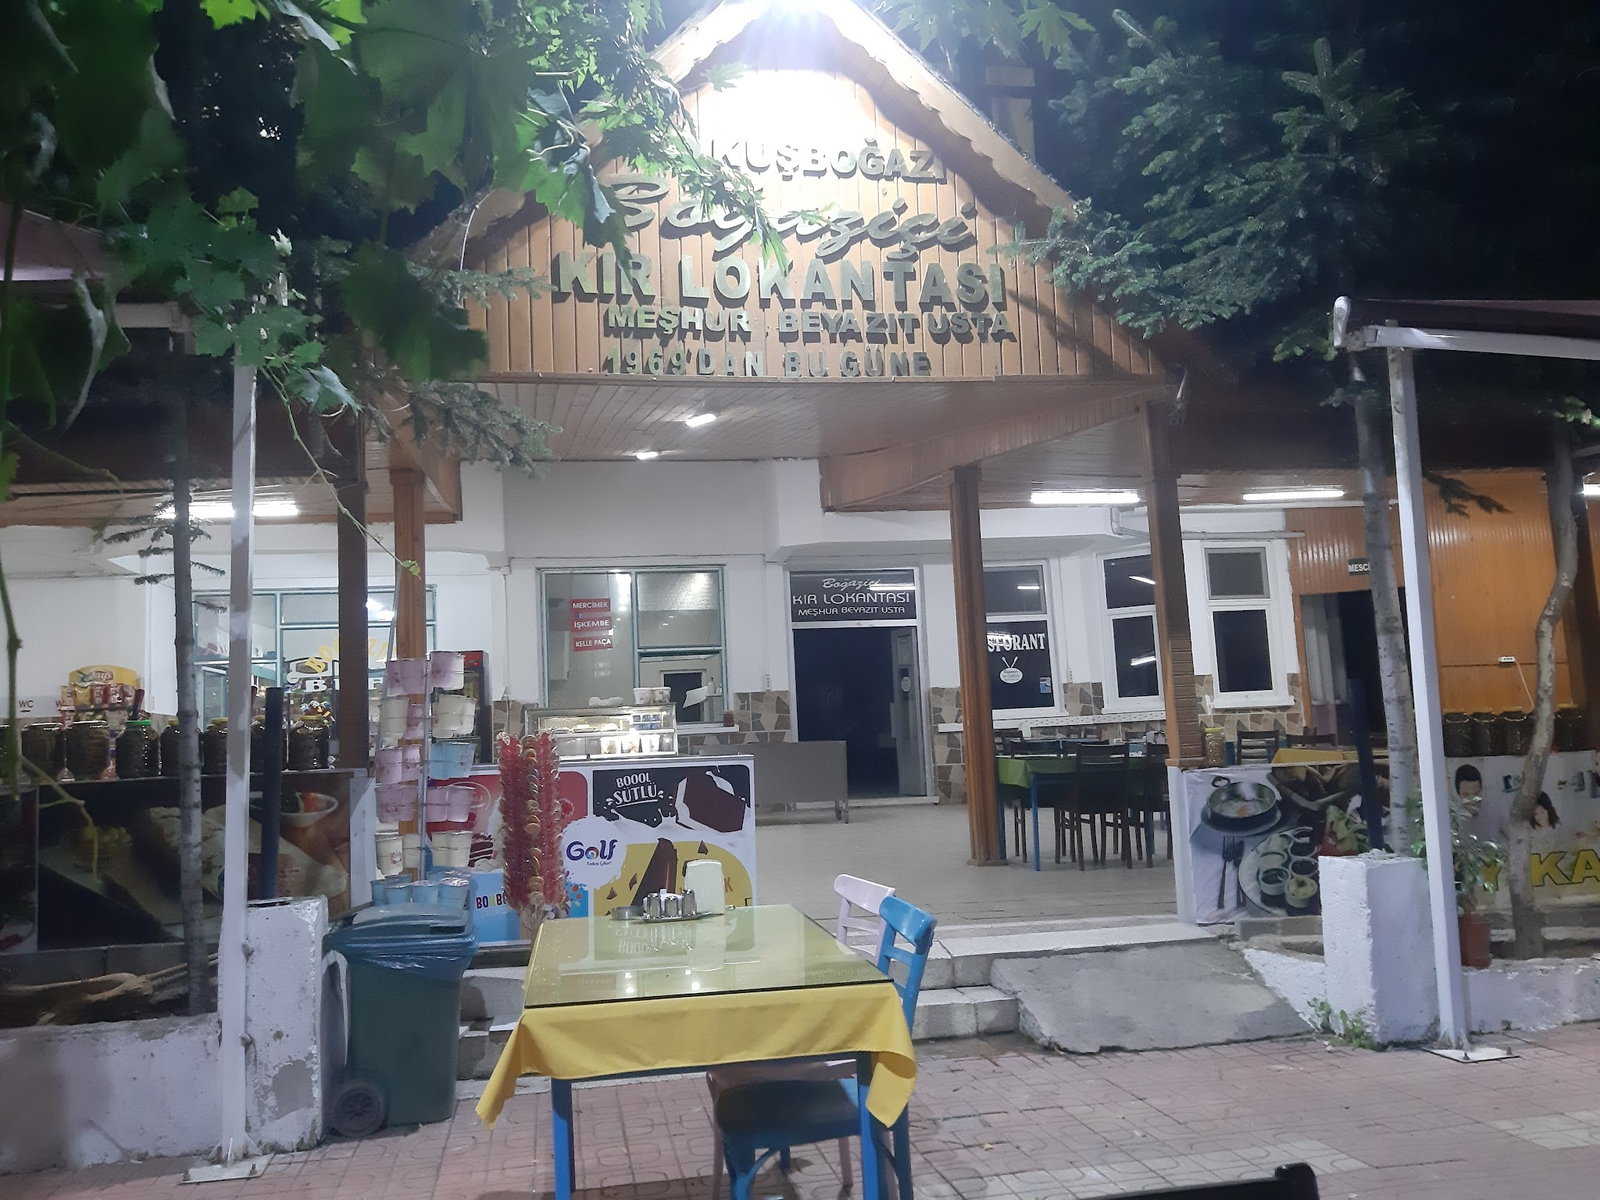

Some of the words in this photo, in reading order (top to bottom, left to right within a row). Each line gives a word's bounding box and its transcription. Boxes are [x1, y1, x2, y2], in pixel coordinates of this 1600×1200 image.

[553, 249, 655, 301] KIR
[680, 254, 1008, 311] LOKANTASI
[604, 304, 752, 340] MEŞHUR
[926, 312, 1016, 343] USTA
[603, 346, 764, 377] 1969'DAN
[783, 350, 830, 377] BU
[840, 345, 932, 377] GÜNE
[792, 594, 818, 605] KIR
[823, 592, 910, 604] LOKANTASI
[798, 607, 838, 616] MEŞHUR
[841, 606, 879, 614] BEYAZIT
[987, 632, 1046, 653] STORANT
[19, 699, 34, 708] WC
[616, 772, 651, 788] BOOOL
[613, 781, 657, 805] SÜTLÜ
[566, 839, 618, 861] Golf
